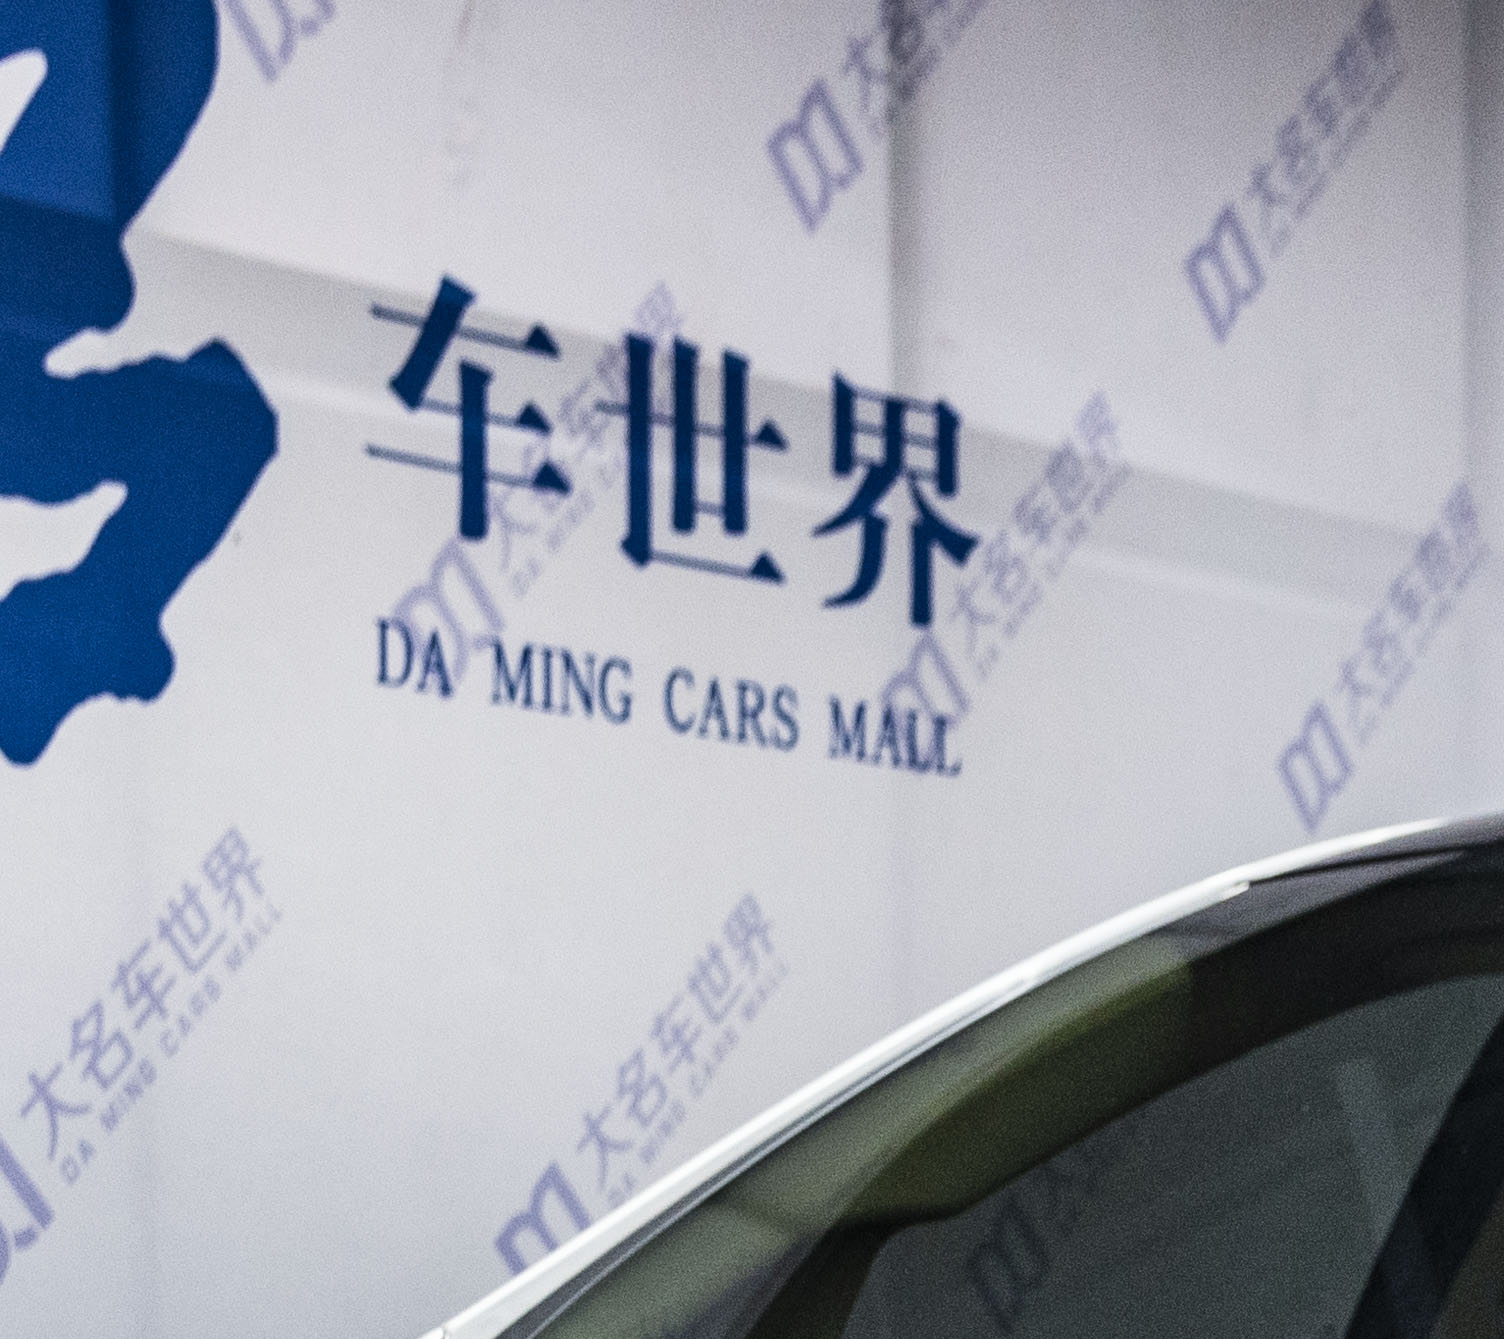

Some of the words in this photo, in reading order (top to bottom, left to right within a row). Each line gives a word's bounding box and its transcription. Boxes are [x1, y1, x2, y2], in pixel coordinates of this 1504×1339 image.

[364, 272, 982, 631] 车世界
[376, 616, 454, 698] DA
[490, 637, 634, 725] MING
[664, 666, 800, 752] CARS
[826, 693, 962, 777] MALL
[20, 825, 265, 1161] 大名车世界
[577, 893, 775, 1192] 大名车世界
